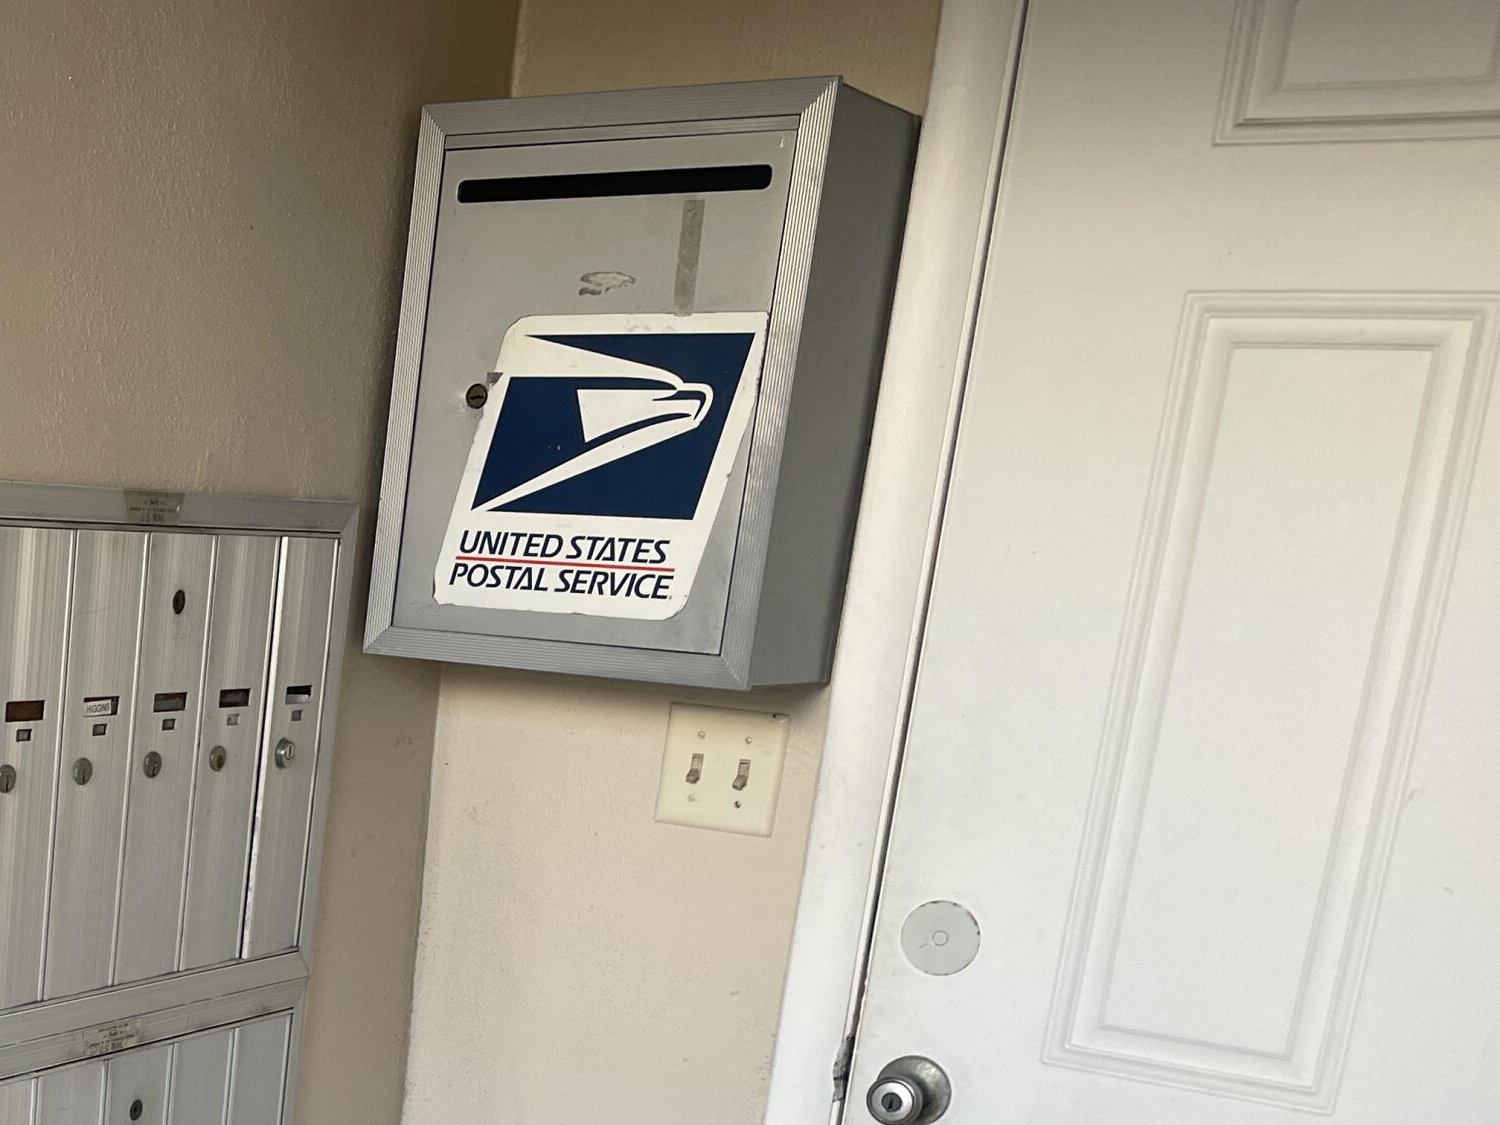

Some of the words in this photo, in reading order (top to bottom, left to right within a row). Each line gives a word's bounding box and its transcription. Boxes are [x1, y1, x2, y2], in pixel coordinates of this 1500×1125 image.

[459, 529, 564, 558] UNITED
[566, 535, 671, 564] STATES
[449, 562, 549, 592] POSTAL
[554, 569, 674, 600] SERVICE
[85, 702, 111, 714] HIGGINS
